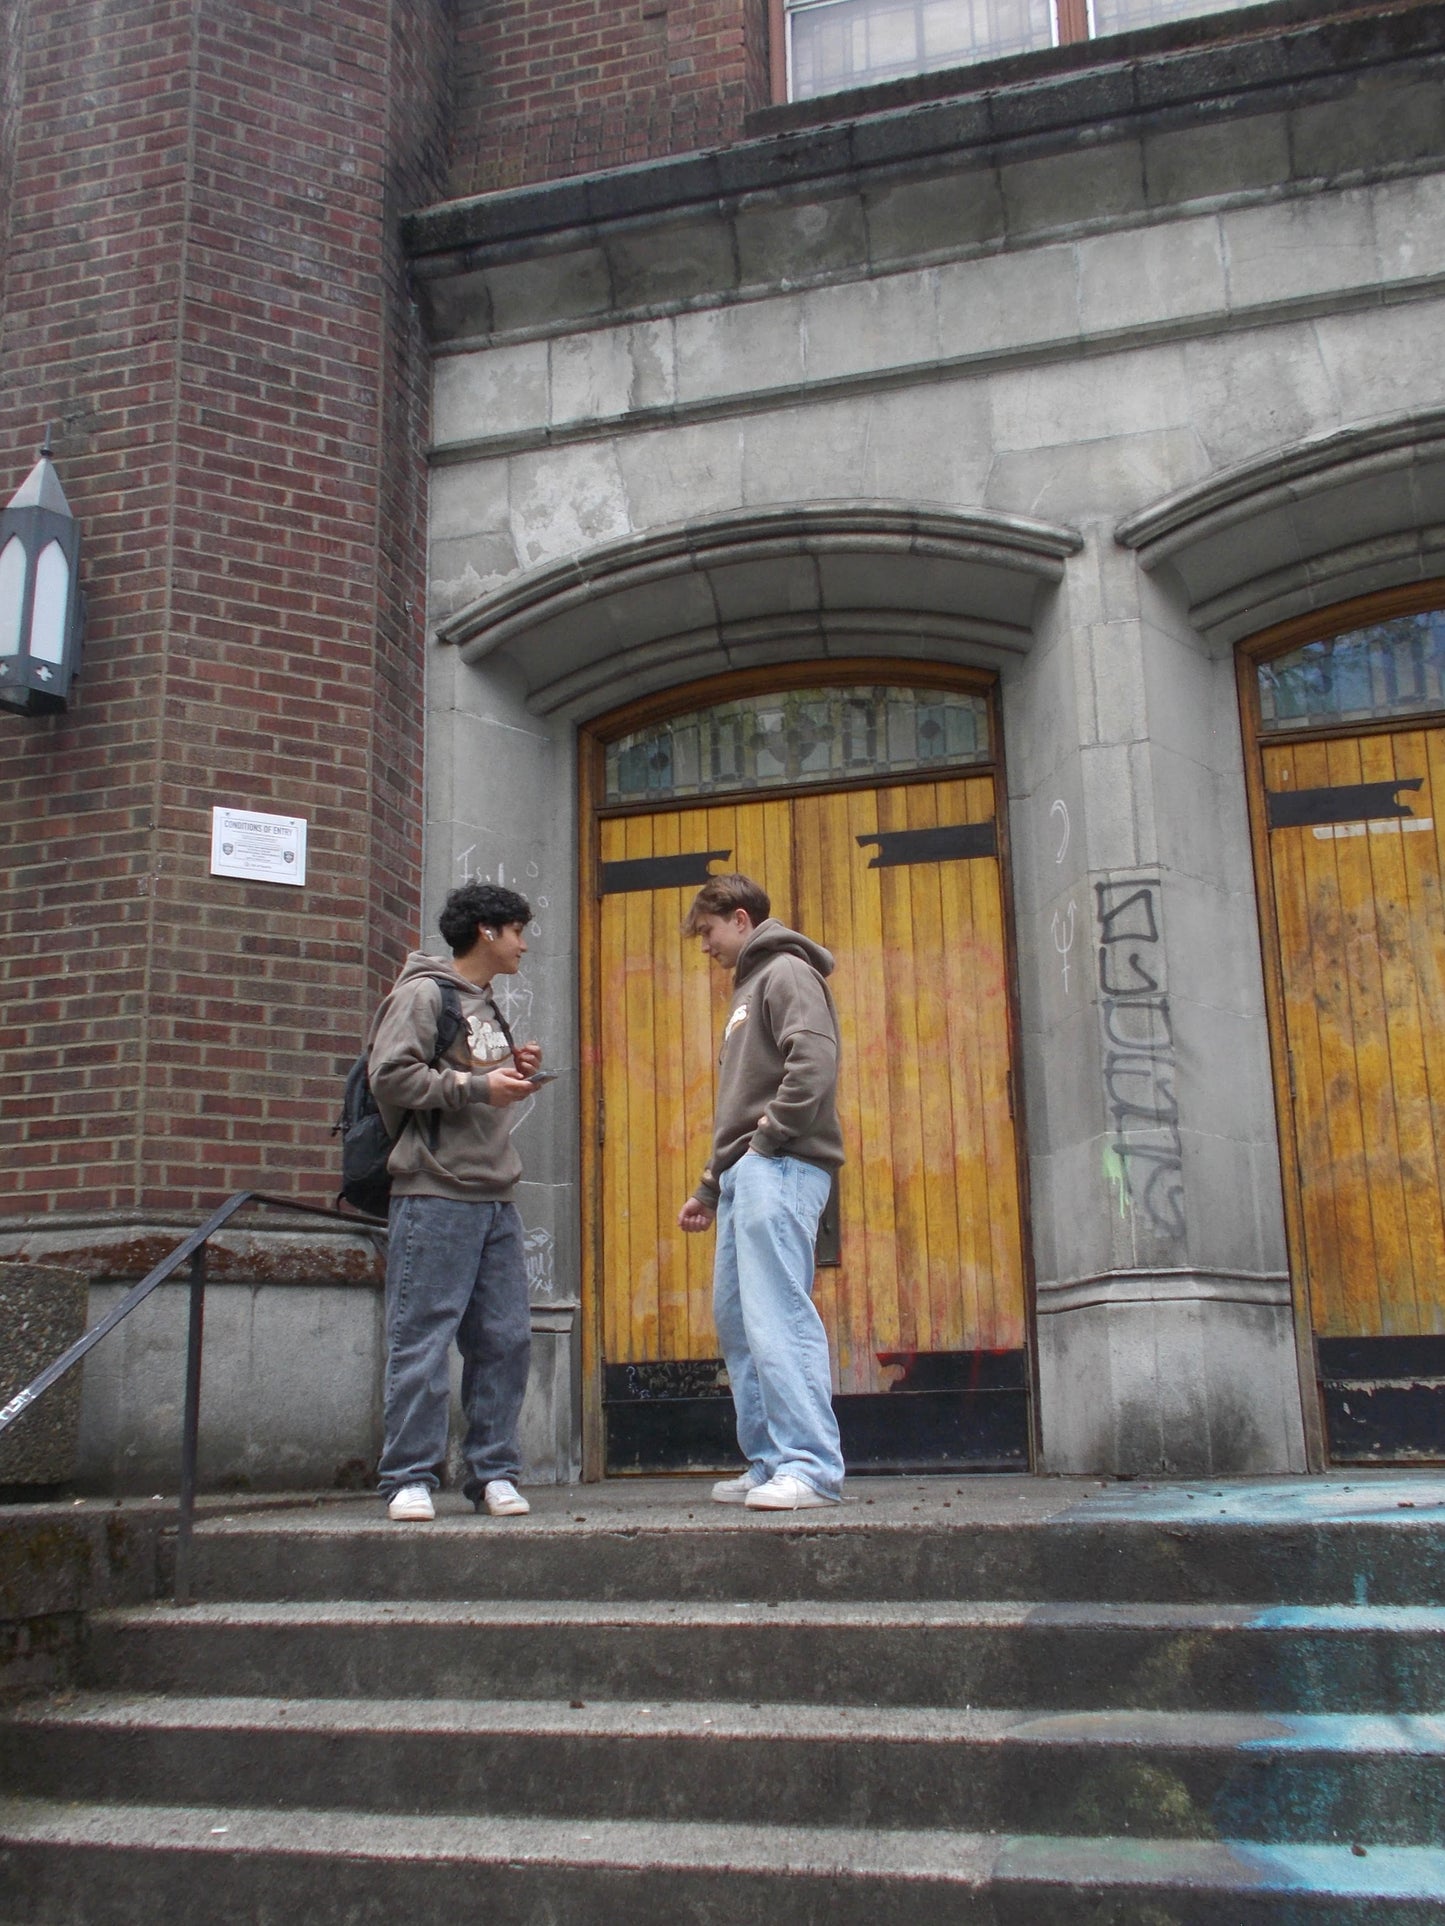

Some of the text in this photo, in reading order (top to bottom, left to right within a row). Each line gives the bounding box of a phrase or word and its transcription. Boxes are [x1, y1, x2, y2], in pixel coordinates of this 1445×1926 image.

[224, 820, 293, 836] CONDITIONS OF ENTRY
